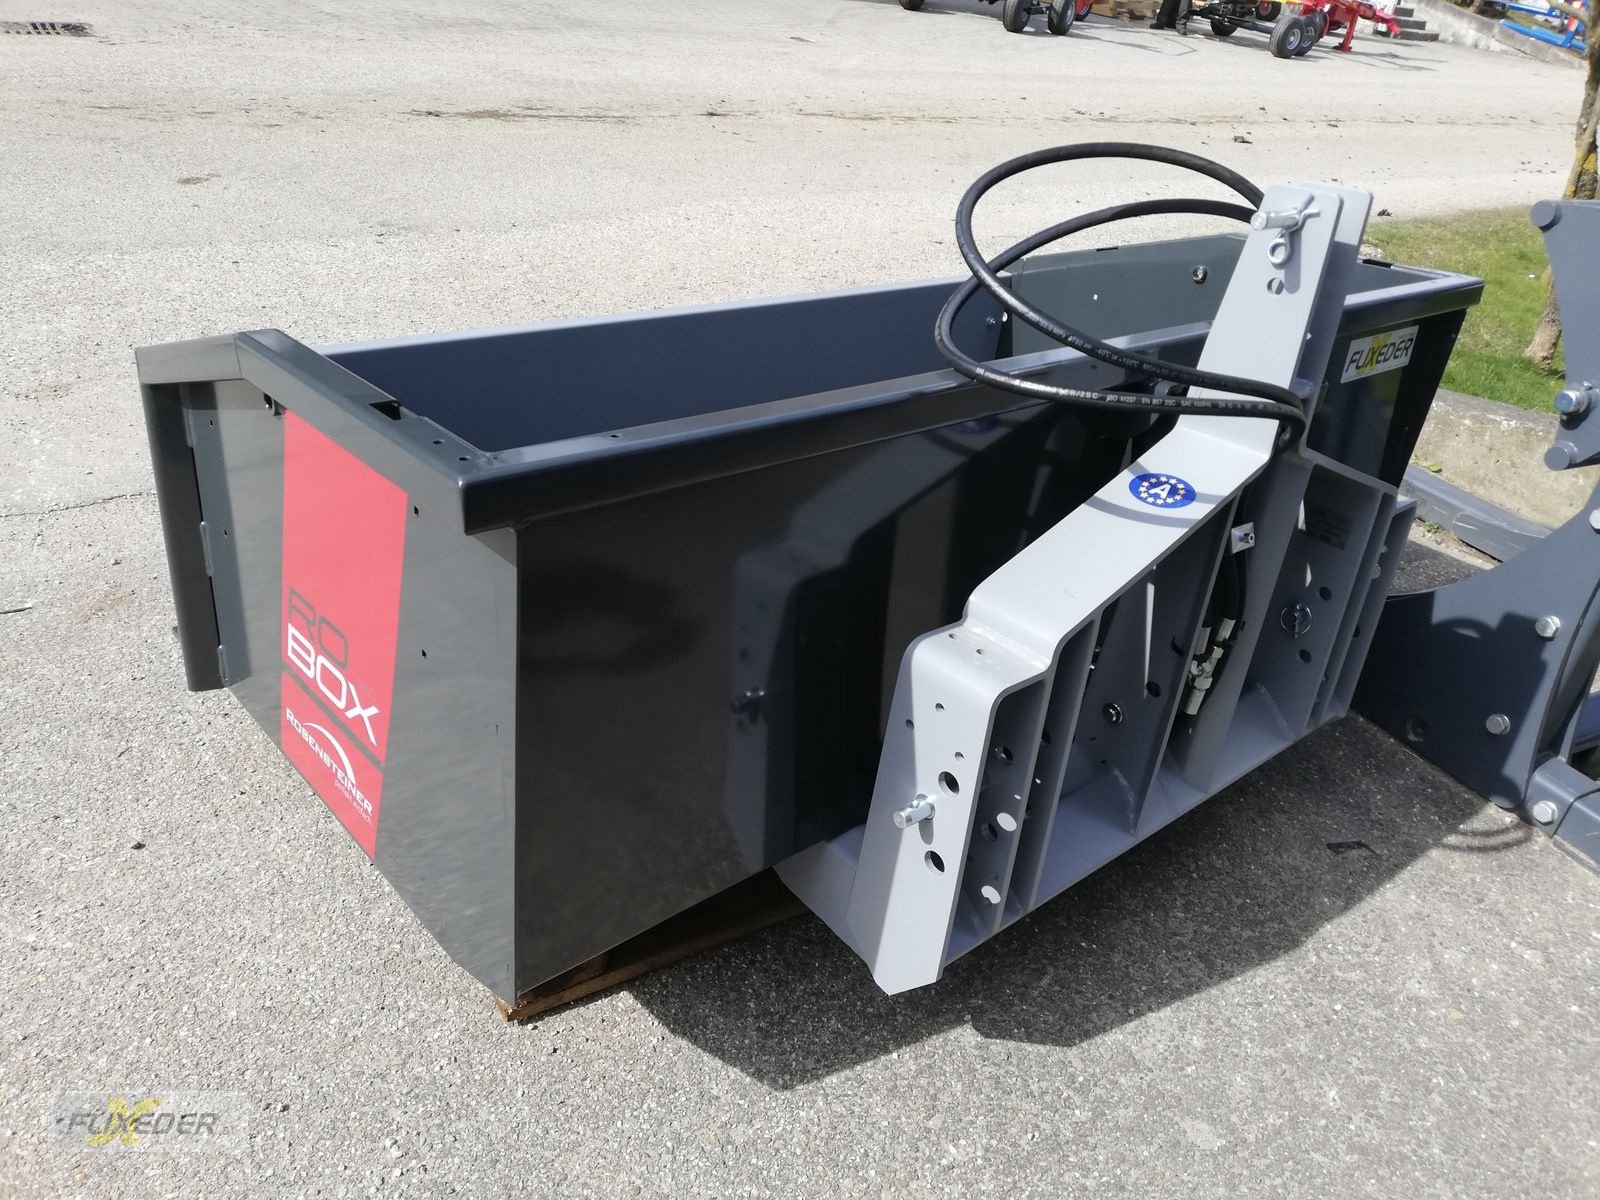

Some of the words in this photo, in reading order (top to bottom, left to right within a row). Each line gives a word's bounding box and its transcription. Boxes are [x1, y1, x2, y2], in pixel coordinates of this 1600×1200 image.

[1148, 483, 1172, 499] A
[288, 585, 349, 670] RO
[287, 622, 380, 747] BOX
[286, 707, 373, 817] ROSENSTEINER
